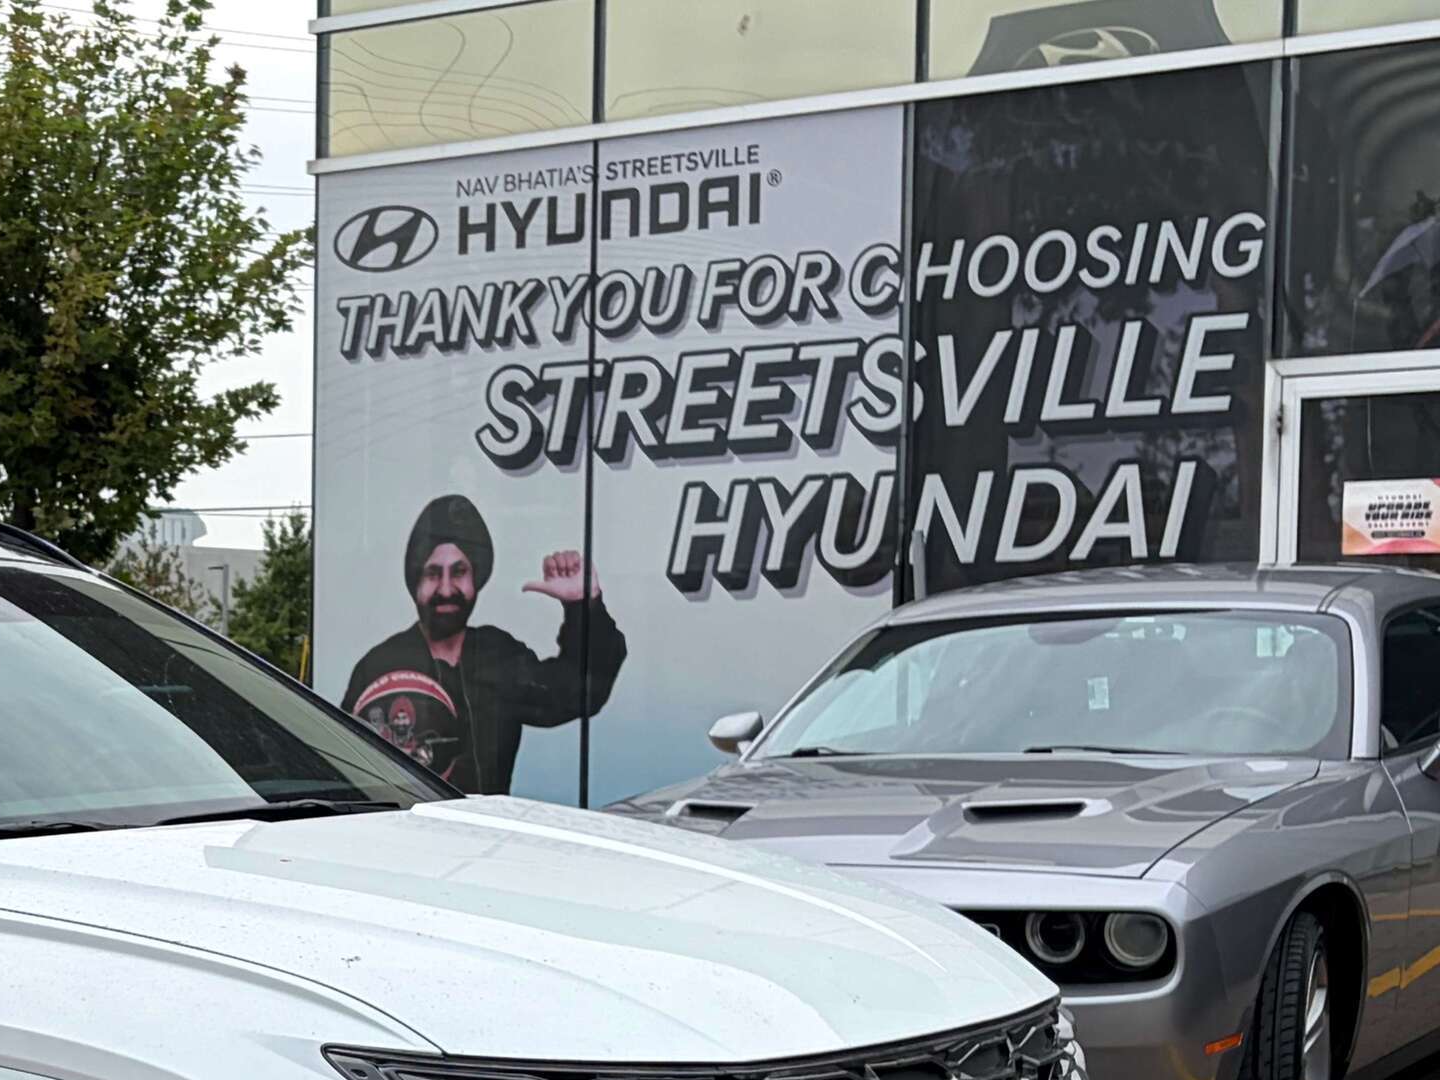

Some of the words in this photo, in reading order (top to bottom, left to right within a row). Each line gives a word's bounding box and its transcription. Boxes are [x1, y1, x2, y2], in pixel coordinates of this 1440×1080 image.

[456, 175, 500, 198] NAV
[504, 164, 598, 193] BHATIA'S
[605, 144, 760, 181] STREETSVILLE
[457, 172, 761, 255] HYUNDAI
[337, 278, 544, 360] THANK
[548, 262, 690, 342] YOU
[699, 250, 840, 330] FOR
[849, 211, 1267, 315] CHOOSING
[475, 312, 1252, 470] STREETSVILLE
[667, 460, 1202, 588] HYUNDAI
